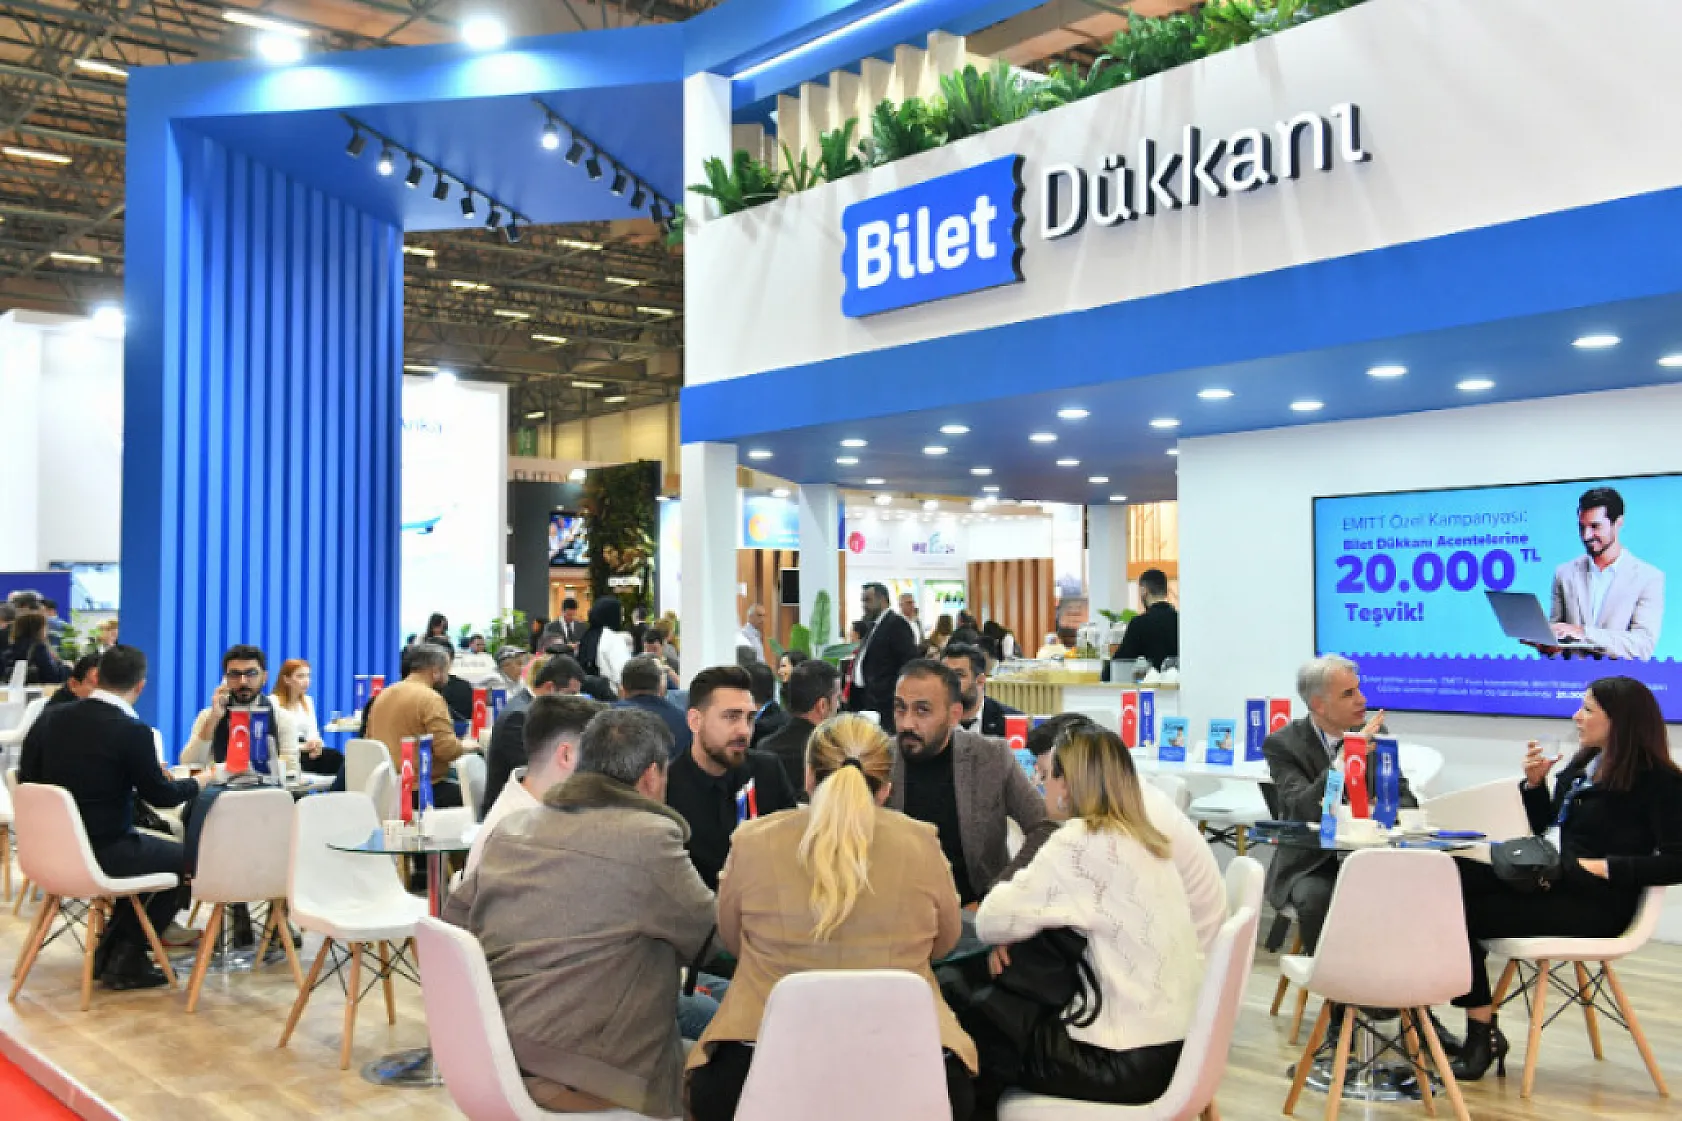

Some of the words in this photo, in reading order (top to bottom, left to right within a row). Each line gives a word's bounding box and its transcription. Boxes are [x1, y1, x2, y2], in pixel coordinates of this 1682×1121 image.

[855, 195, 999, 290] Bilet
[1039, 101, 1373, 241] Dükkanı
[1436, 530, 1529, 547] Acentelerine
[1336, 549, 1515, 594] 20.000
[1519, 547, 1542, 562] TL
[1344, 600, 1424, 626] Teşvik!
